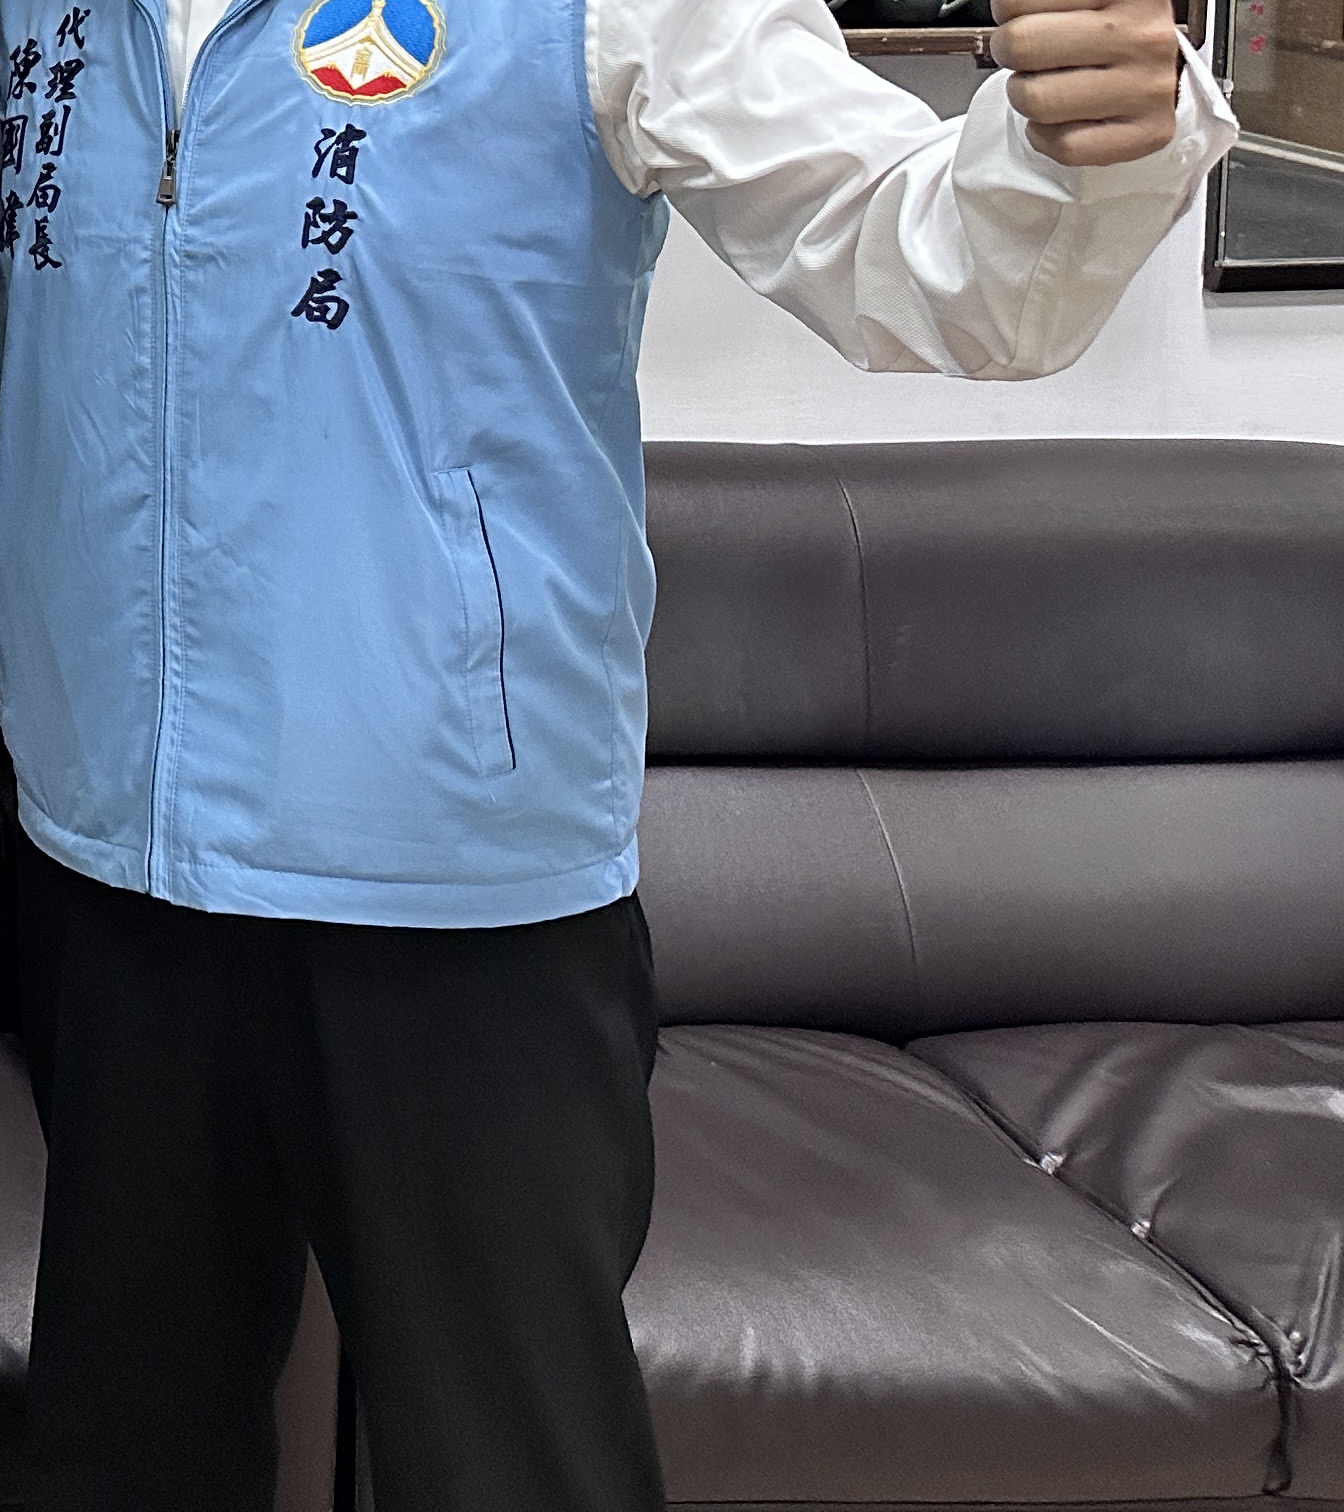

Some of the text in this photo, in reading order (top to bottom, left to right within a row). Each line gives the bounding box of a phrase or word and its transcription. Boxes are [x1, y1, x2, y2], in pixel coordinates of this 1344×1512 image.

[26, 6, 92, 271] 代理副局長
[290, 123, 367, 331] 消防局
